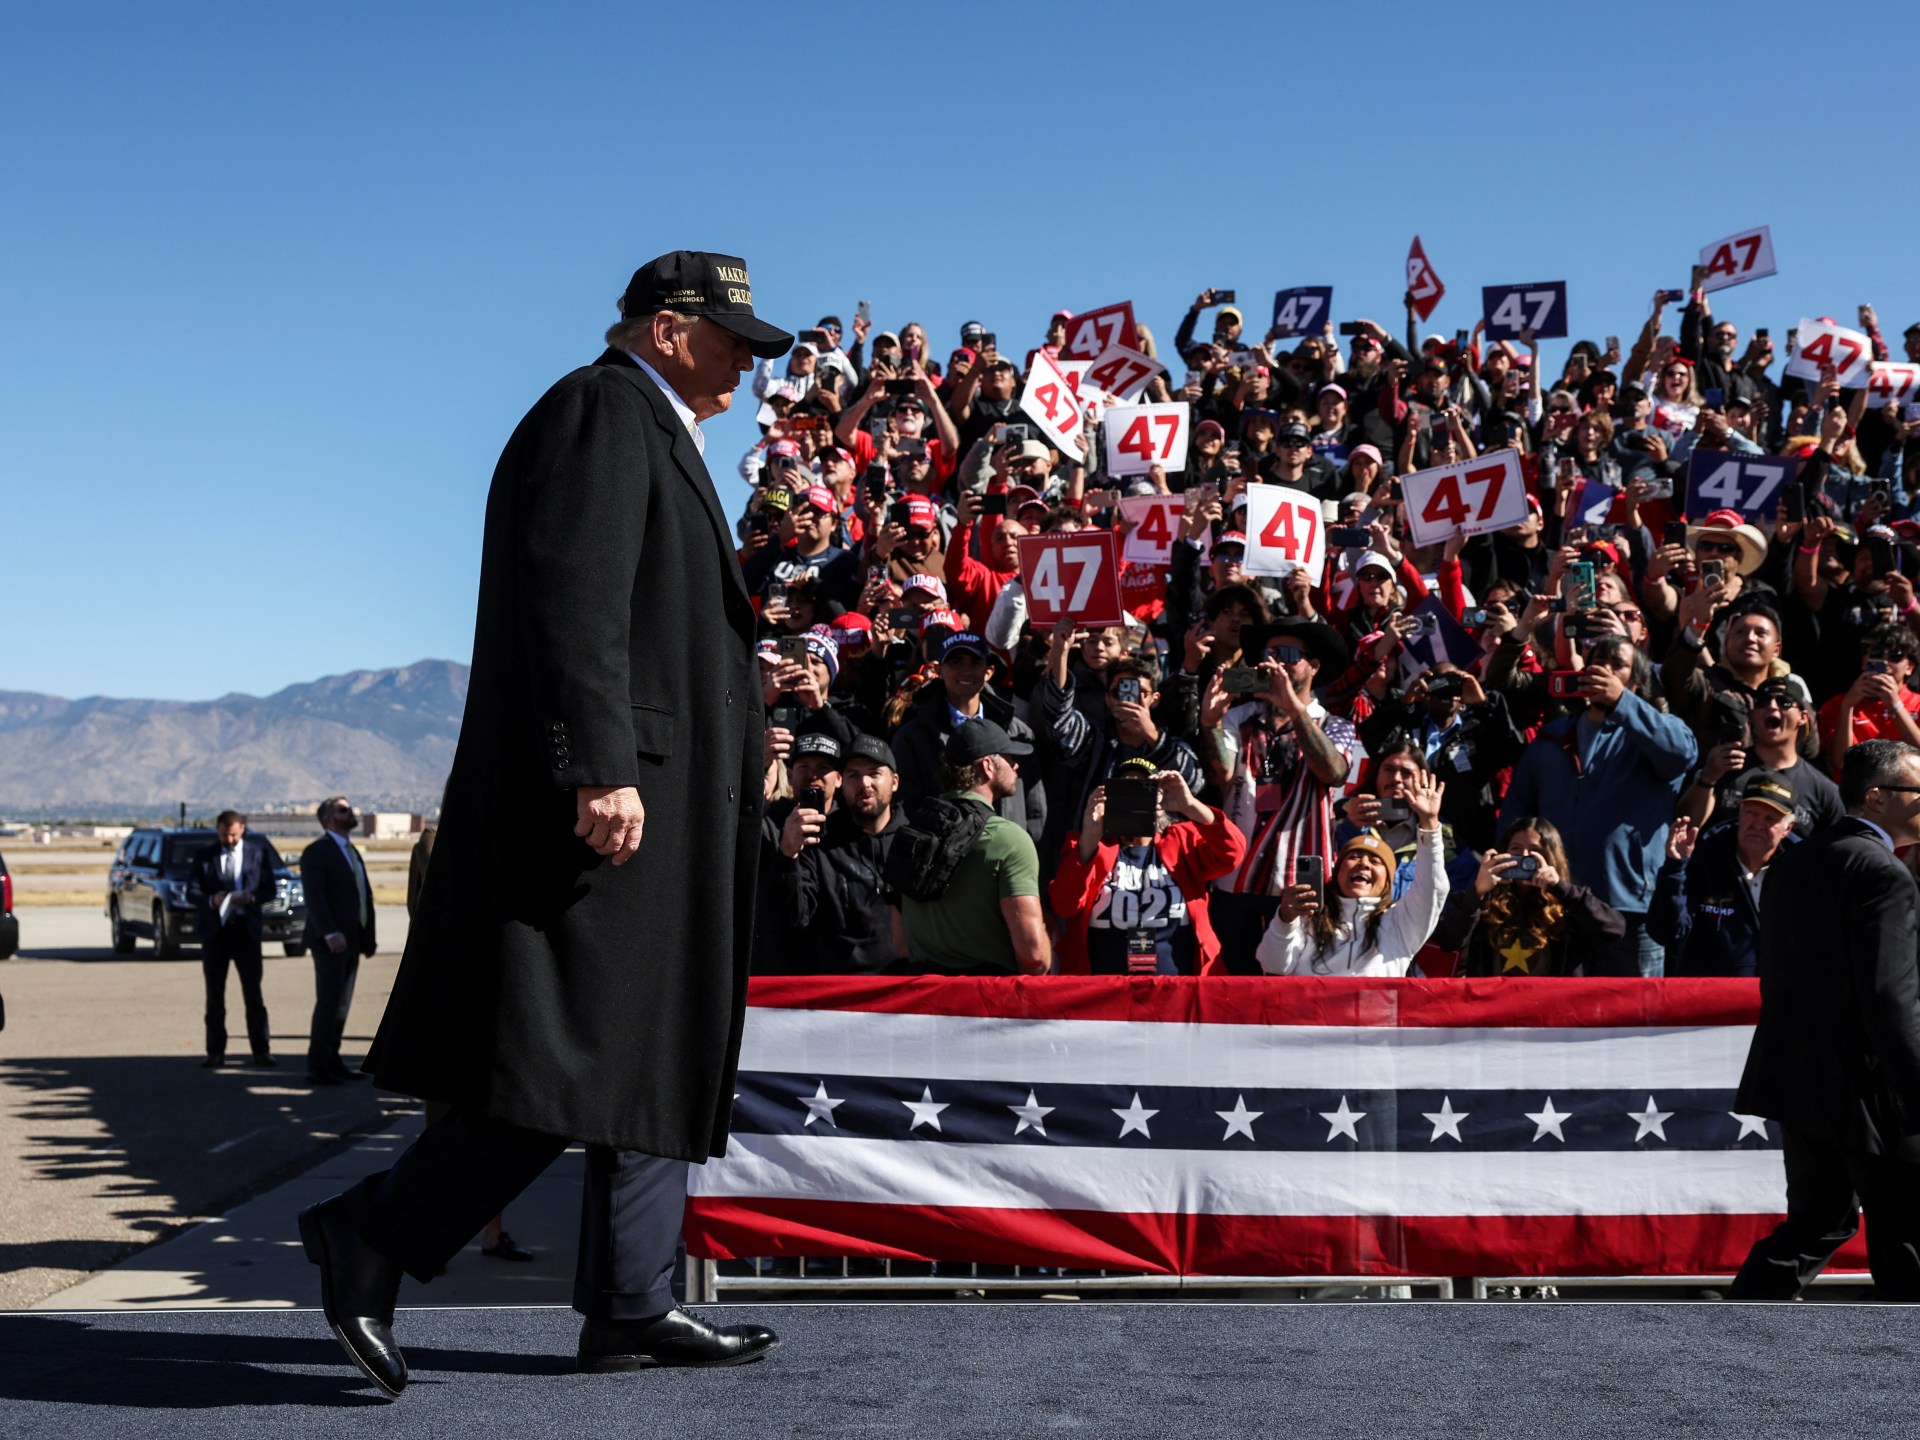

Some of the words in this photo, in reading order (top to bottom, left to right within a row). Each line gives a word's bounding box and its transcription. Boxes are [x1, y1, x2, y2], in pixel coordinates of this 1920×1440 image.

[716, 266, 744, 283] MAKE
[1705, 234, 1762, 276] 47
[664, 296, 706, 304] SURRENDER
[1277, 296, 1324, 330] 47
[1491, 290, 1556, 332] 47
[1070, 311, 1126, 357] 47
[1802, 334, 1863, 375] 47
[1091, 356, 1152, 397] 47
[1868, 369, 1915, 398] 47
[1035, 382, 1079, 434] 47
[1117, 414, 1180, 461] 47
[1421, 463, 1507, 526] 47
[1697, 460, 1784, 510] 47
[1260, 501, 1317, 564] 47
[903, 573, 937, 591] TRUMP
[1030, 546, 1103, 612] 47
[808, 640, 826, 657] 24
[943, 633, 980, 648] TRUMP
[1089, 887, 1190, 930] 2024
[1700, 904, 1734, 916] TRUMP
